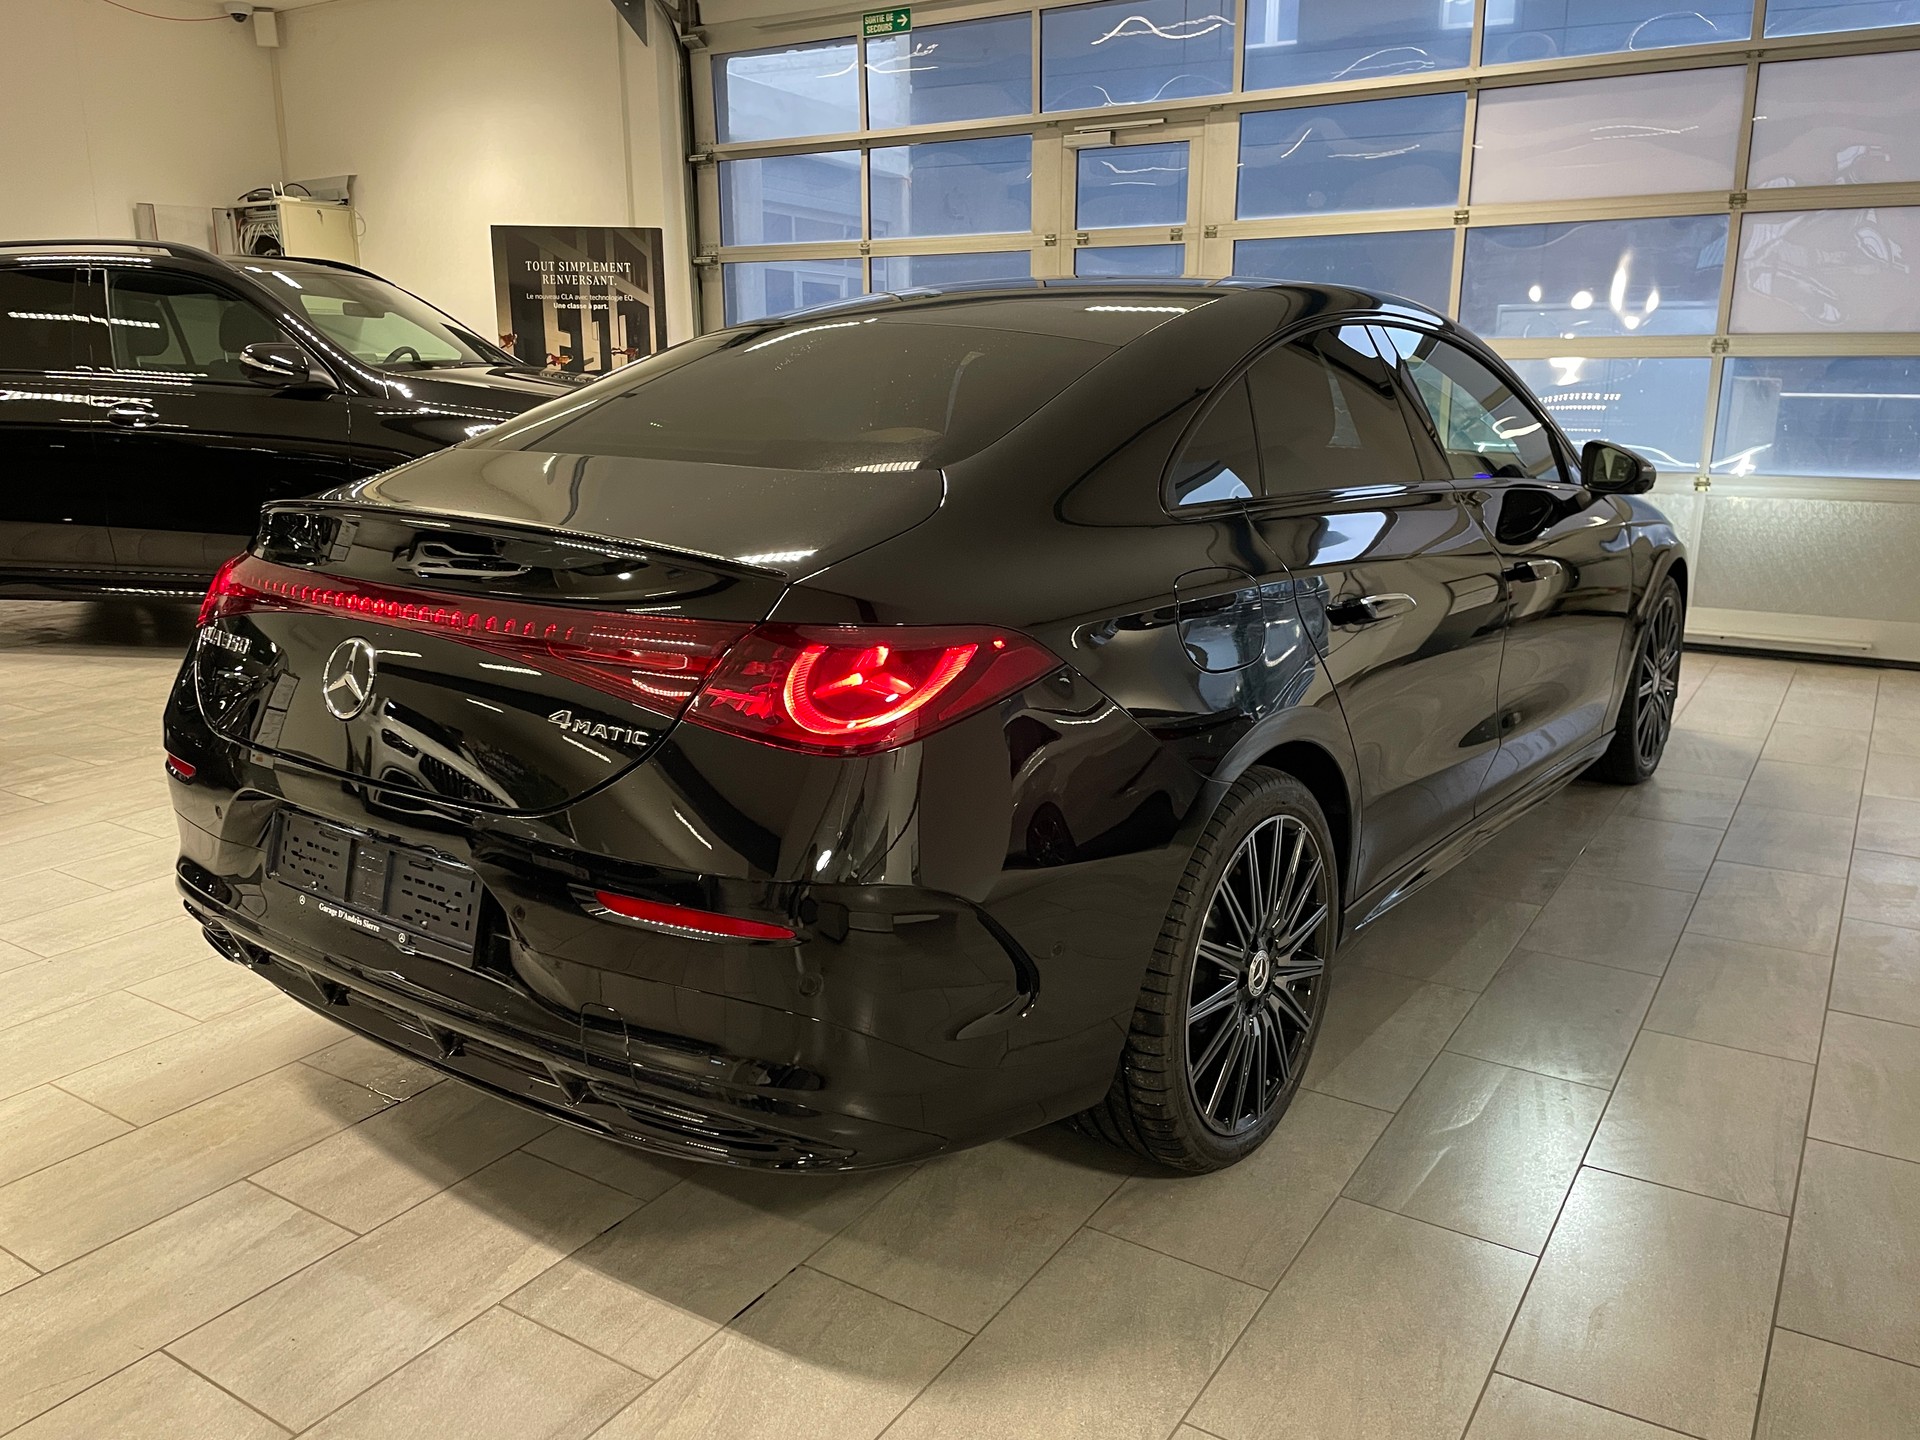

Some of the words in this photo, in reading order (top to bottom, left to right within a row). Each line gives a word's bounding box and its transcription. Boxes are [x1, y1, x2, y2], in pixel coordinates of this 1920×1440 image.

[865, 15, 885, 24] SORTIE
[886, 13, 894, 22] DE
[866, 23, 893, 34] SECOURS
[525, 260, 555, 272] TOUT
[558, 261, 631, 273] SIMPLEMENT
[542, 274, 618, 286] RENVERSANT.
[560, 293, 574, 301] CLA
[589, 294, 623, 303] technologie
[553, 302, 566, 310] Une
[567, 302, 587, 310] classe
[593, 303, 609, 311] part.
[547, 709, 650, 747] 4MATIC
[318, 902, 338, 917] Garage
[362, 919, 381, 933] Sierre
